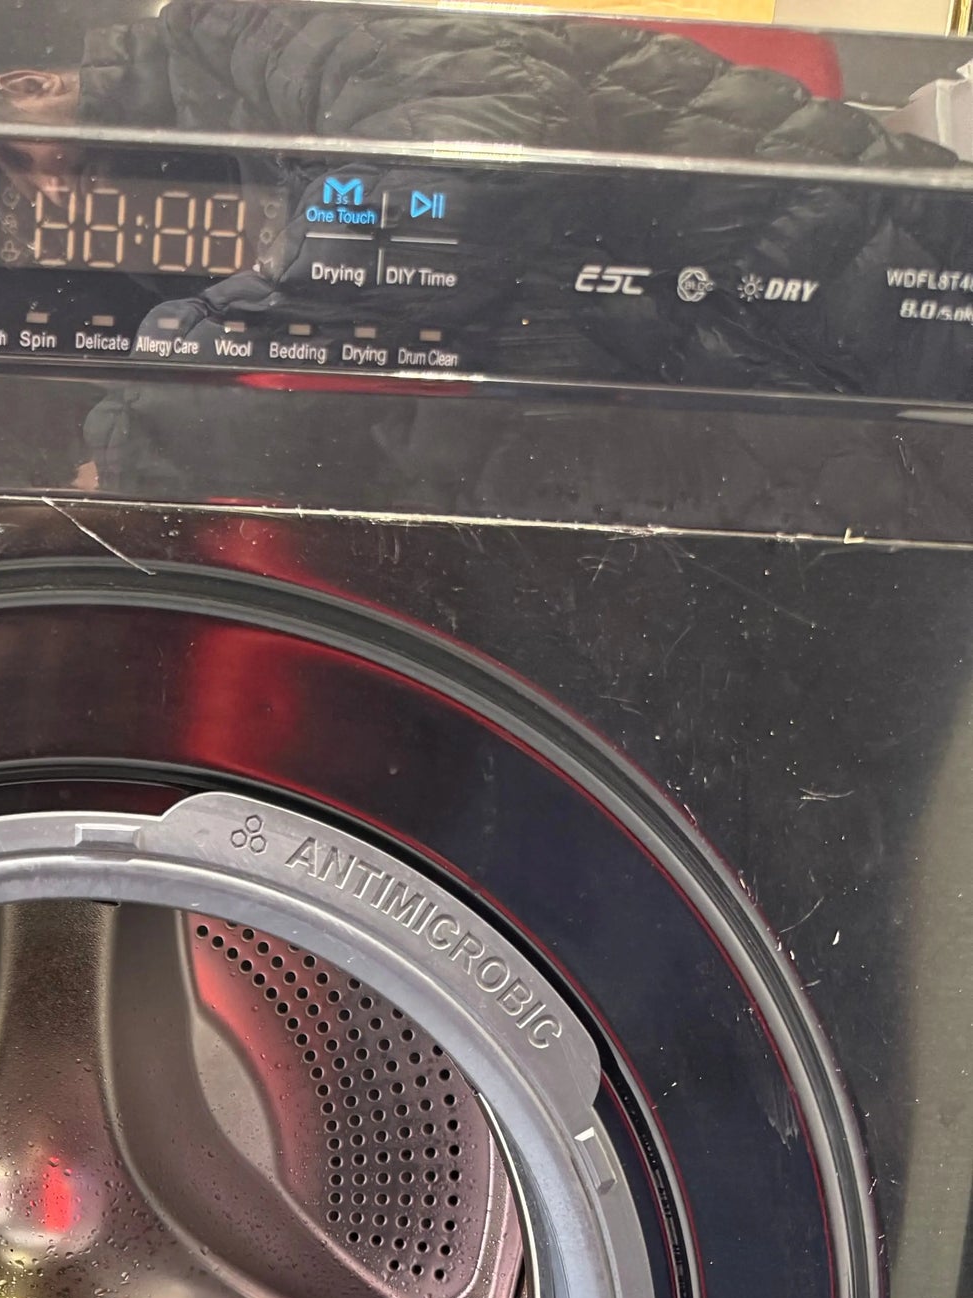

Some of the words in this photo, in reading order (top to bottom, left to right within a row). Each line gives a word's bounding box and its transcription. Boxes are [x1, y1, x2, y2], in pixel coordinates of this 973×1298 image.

[306, 206, 334, 223] One
[336, 207, 375, 225] Touch
[311, 262, 367, 288] Drying
[386, 267, 415, 285] DIY
[417, 269, 458, 288] Time
[764, 278, 819, 303] DRY
[19, 330, 56, 353] Spin
[75, 332, 129, 352] Delicate
[135, 337, 173, 357] Allergy
[173, 338, 199, 355] Care
[215, 340, 252, 358] Wool
[269, 343, 327, 364] Bedding
[342, 344, 387, 366] Drying
[398, 348, 426, 366] Drum
[427, 350, 458, 368] Clean
[284, 835, 563, 1050] ANTIMICROBIC
